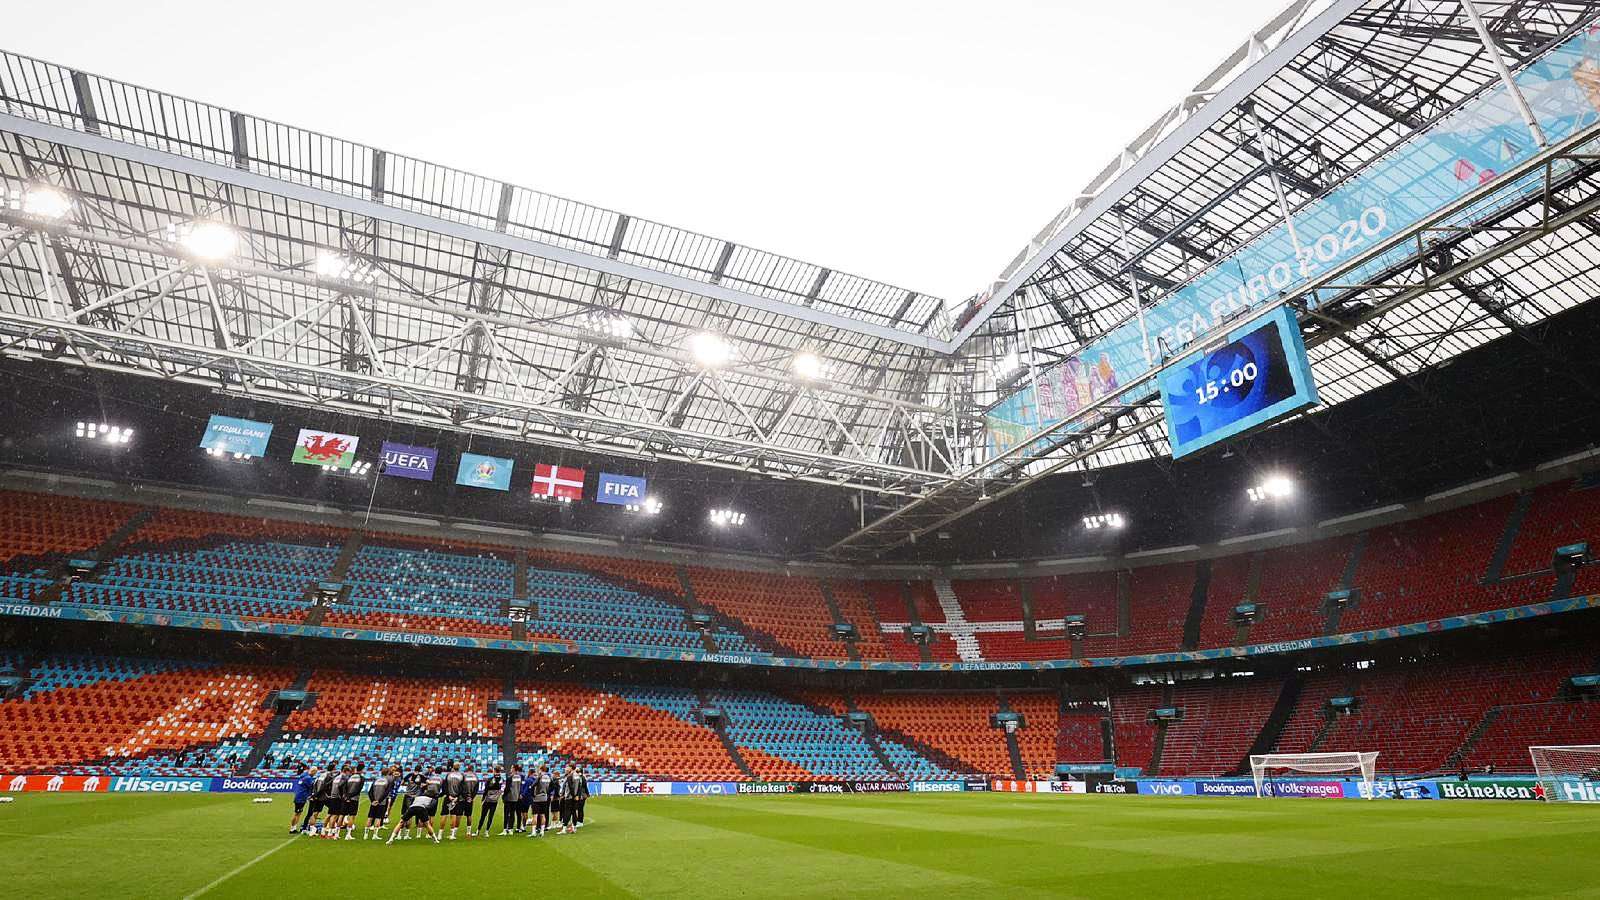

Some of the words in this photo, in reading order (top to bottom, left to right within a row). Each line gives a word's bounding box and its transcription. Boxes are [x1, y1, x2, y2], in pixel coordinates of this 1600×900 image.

[1296, 206, 1387, 279] 2020
[1195, 362, 1258, 405] 15:00
[386, 452, 429, 470] UEFA
[605, 482, 638, 498] FIFA
[375, 632, 402, 642] UEFA
[403, 634, 432, 644] EURO
[433, 636, 458, 646] 2020
[1254, 639, 1313, 654] AMSTERDAM
[701, 654, 752, 664] AMSTERDAM
[960, 662, 980, 671] UEFA
[980, 662, 1001, 671] EURO
[1002, 662, 1022, 670] 2020
[114, 776, 203, 792] Hisense
[222, 779, 293, 792] Booking.com
[623, 782, 655, 794] FedEx
[739, 782, 786, 794] Heineken
[818, 783, 843, 793] TikTok
[855, 782, 879, 792] QATAR
[881, 782, 910, 792] AIRWAYS
[913, 782, 960, 792] Hisense
[1051, 782, 1073, 792] FedEx
[1104, 782, 1126, 793] TikTok
[1203, 782, 1255, 795] Booking.com
[1278, 782, 1340, 796] Volkswagen
[1441, 783, 1531, 799] Heineken
